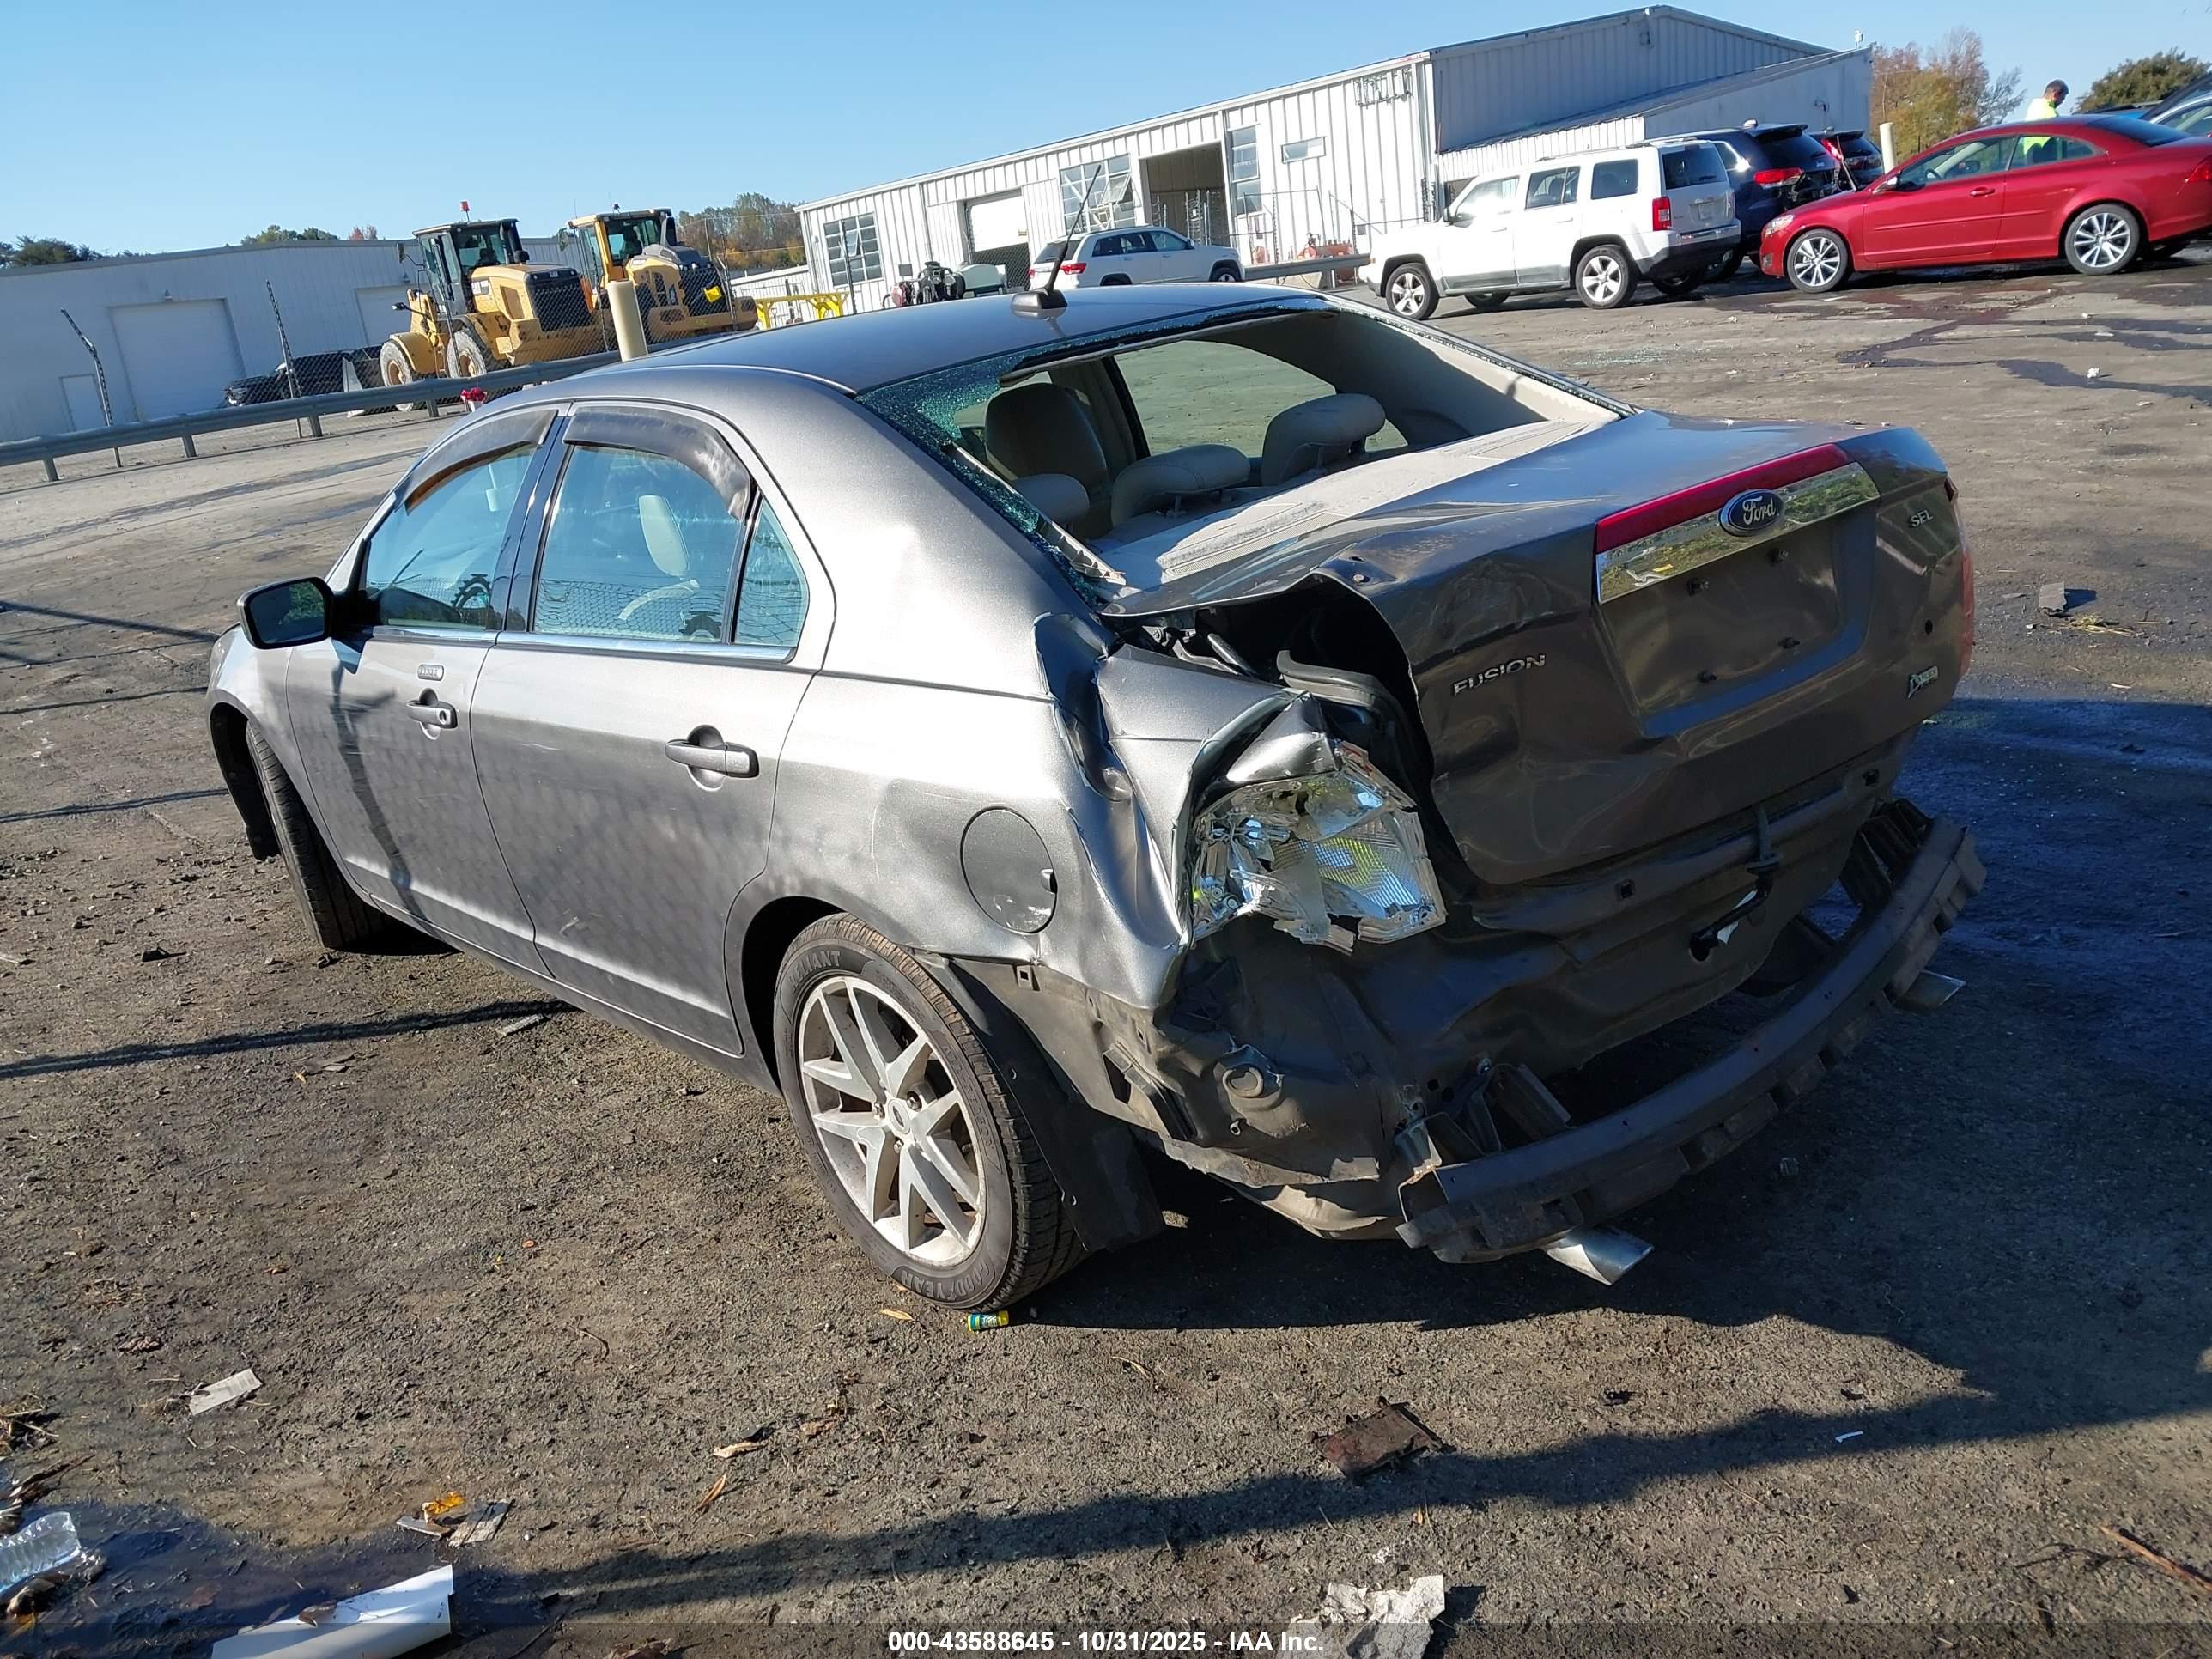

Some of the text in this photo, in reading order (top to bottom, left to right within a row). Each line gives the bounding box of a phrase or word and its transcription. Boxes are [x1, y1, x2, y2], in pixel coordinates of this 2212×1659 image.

[1742, 495, 1776, 525] Ford
[1909, 509, 1933, 527] SEL
[1453, 654, 1546, 696] FUSION
